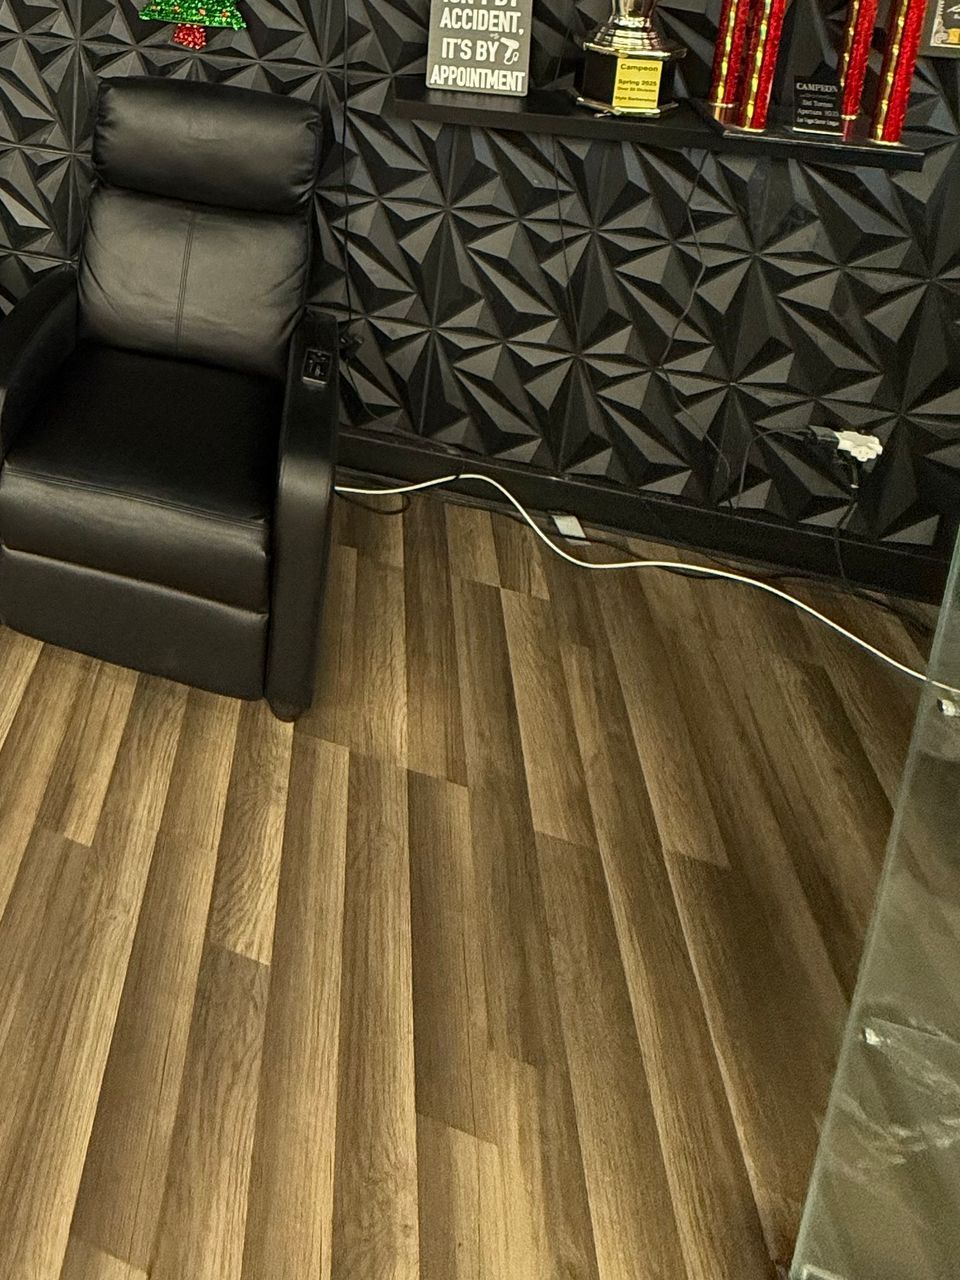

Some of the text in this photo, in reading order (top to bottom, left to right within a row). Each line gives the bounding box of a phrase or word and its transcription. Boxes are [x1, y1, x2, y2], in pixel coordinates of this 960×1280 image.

[440, 6, 525, 36] ACCIDENT,
[441, 37, 500, 62] IT'S BY
[430, 64, 526, 92] APPOINTMENT
[620, 63, 659, 72] Campeon
[618, 78, 640, 87] Spring
